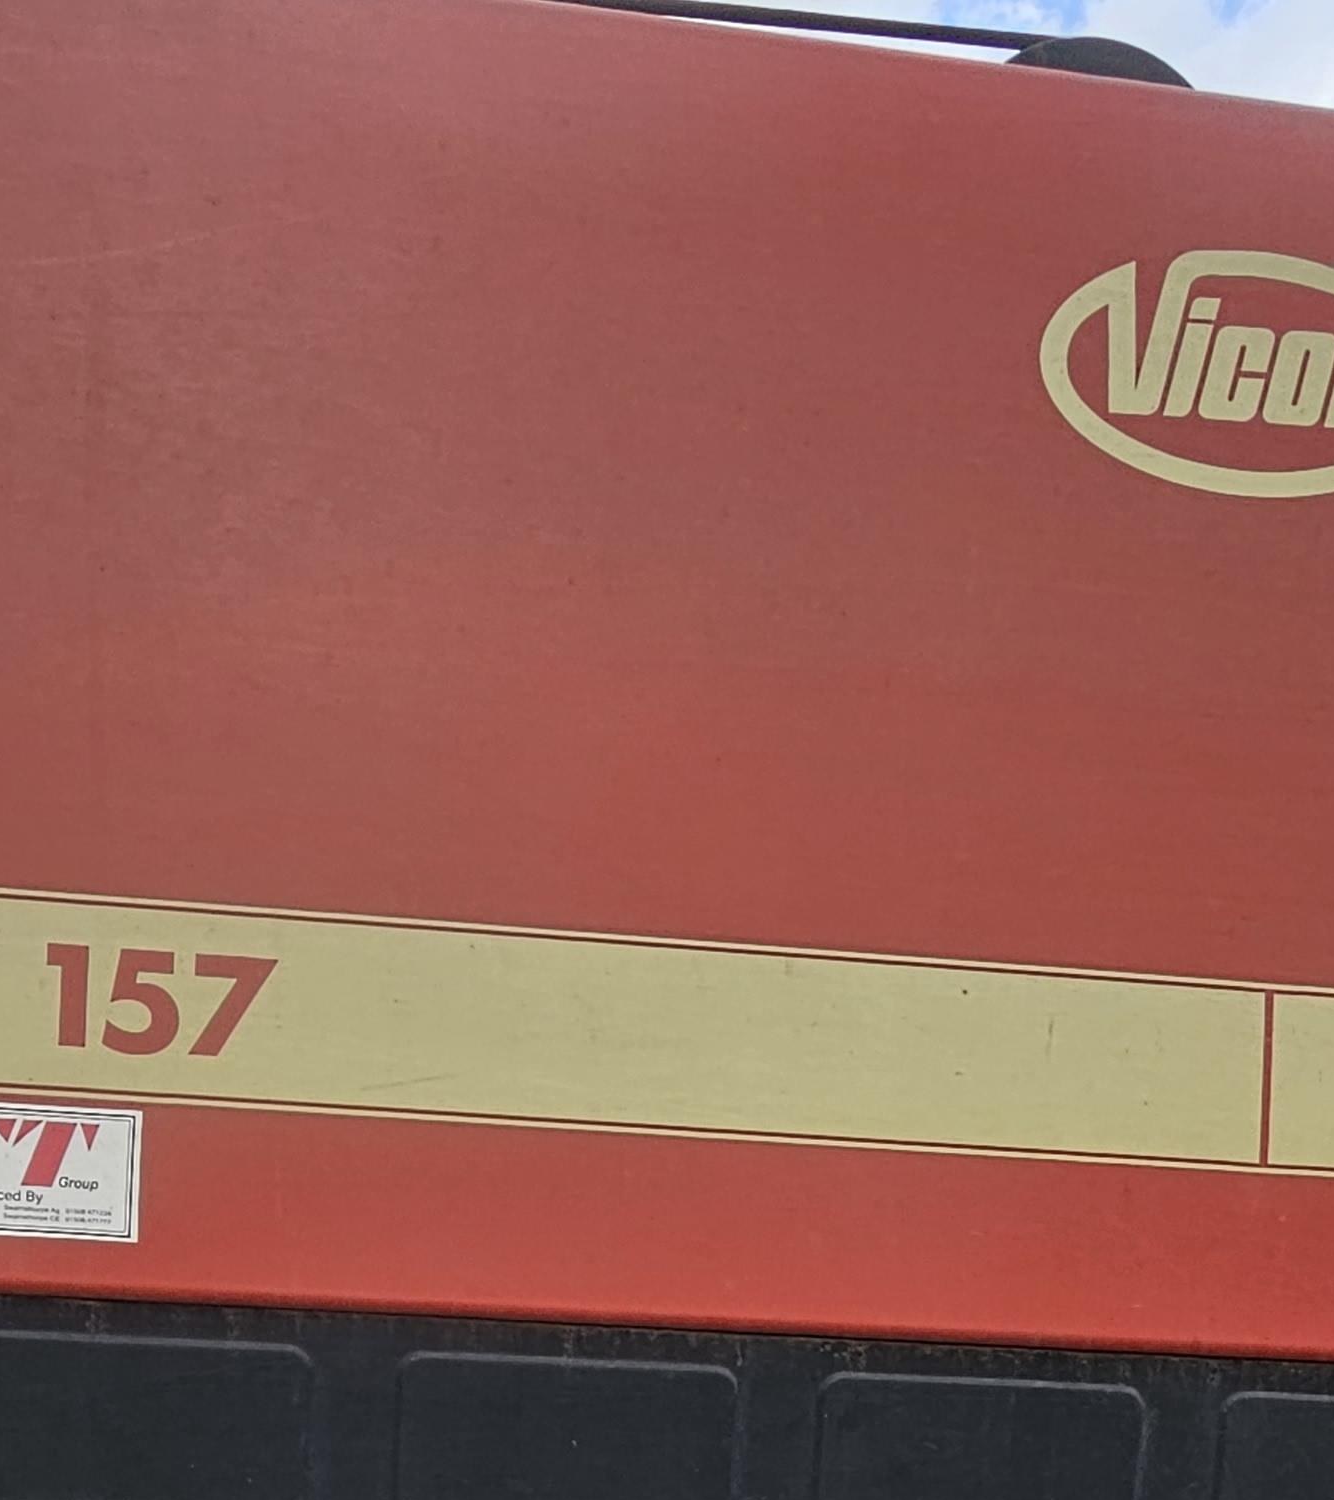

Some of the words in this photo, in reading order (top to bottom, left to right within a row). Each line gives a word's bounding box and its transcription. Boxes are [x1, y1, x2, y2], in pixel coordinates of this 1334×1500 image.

[45, 941, 280, 1056] 157
[58, 1176, 99, 1191] Group
[25, 1189, 44, 1205] By
